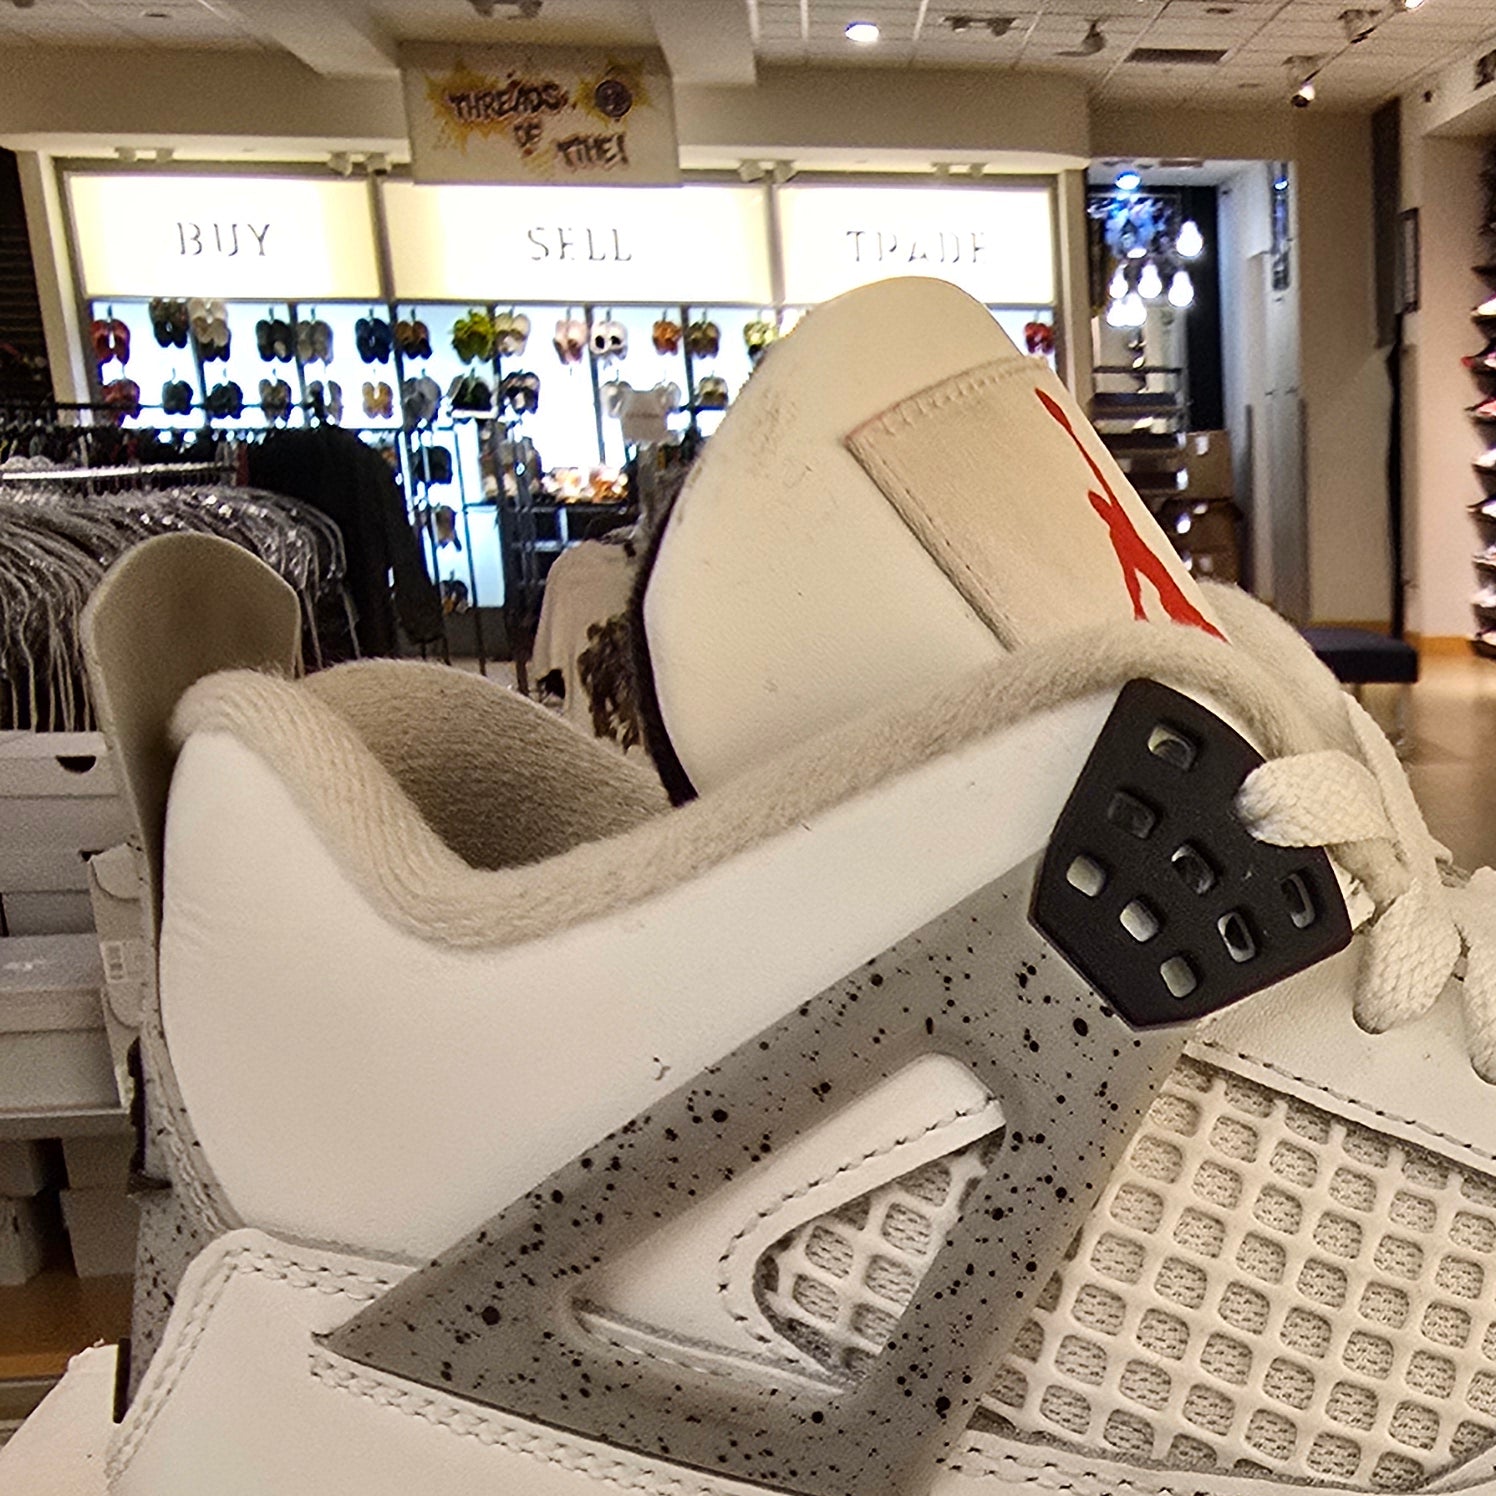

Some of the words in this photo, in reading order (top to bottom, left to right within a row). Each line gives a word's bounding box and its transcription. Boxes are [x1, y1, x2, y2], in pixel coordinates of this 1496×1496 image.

[177, 221, 271, 257] BUY
[526, 226, 633, 261] SELL
[845, 230, 986, 264] TRADE
